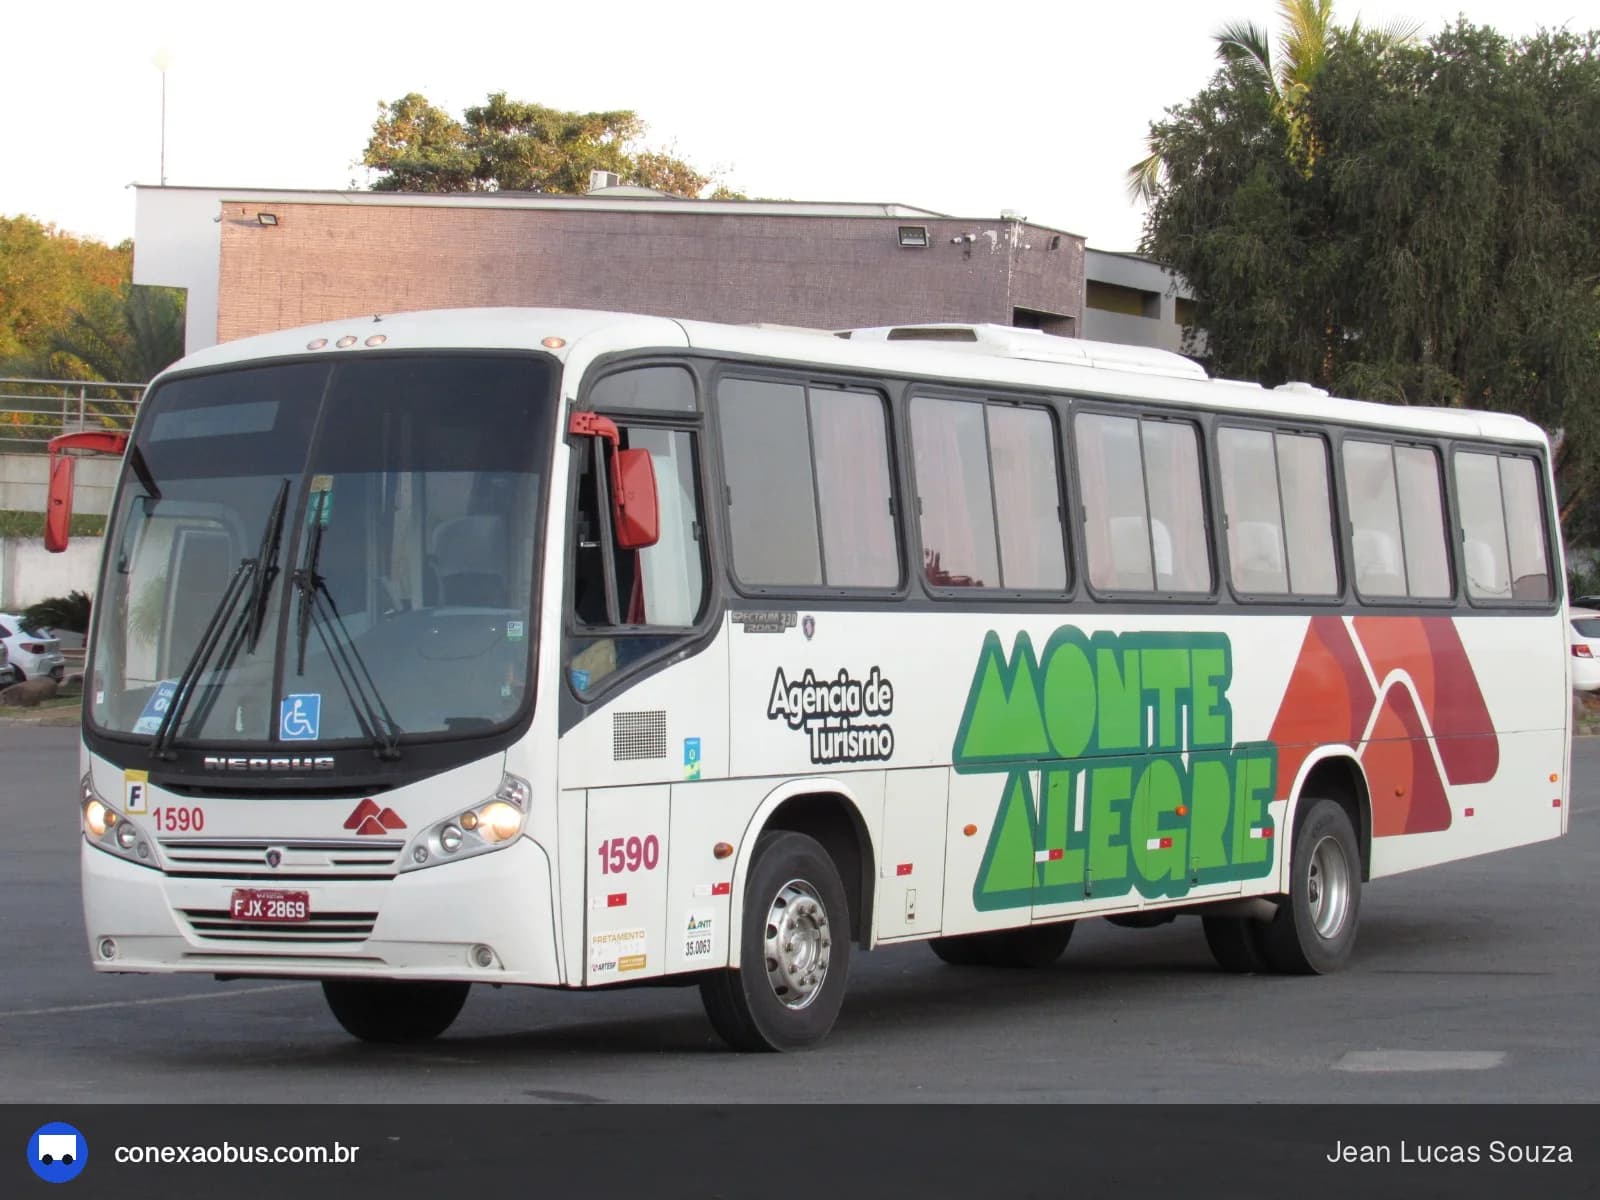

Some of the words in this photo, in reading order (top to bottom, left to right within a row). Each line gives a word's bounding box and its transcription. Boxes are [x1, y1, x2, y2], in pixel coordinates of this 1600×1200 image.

[768, 667, 862, 729] Agência
[863, 666, 893, 717] de
[957, 632, 1230, 760] MONTE
[804, 717, 894, 764] Turismo
[204, 757, 335, 771] NEOBUS
[129, 785, 142, 807] F
[152, 807, 205, 832] 1590
[978, 752, 1275, 900] ALEGRE
[598, 834, 660, 875] 1590
[592, 930, 646, 945] FRETAMENTO
